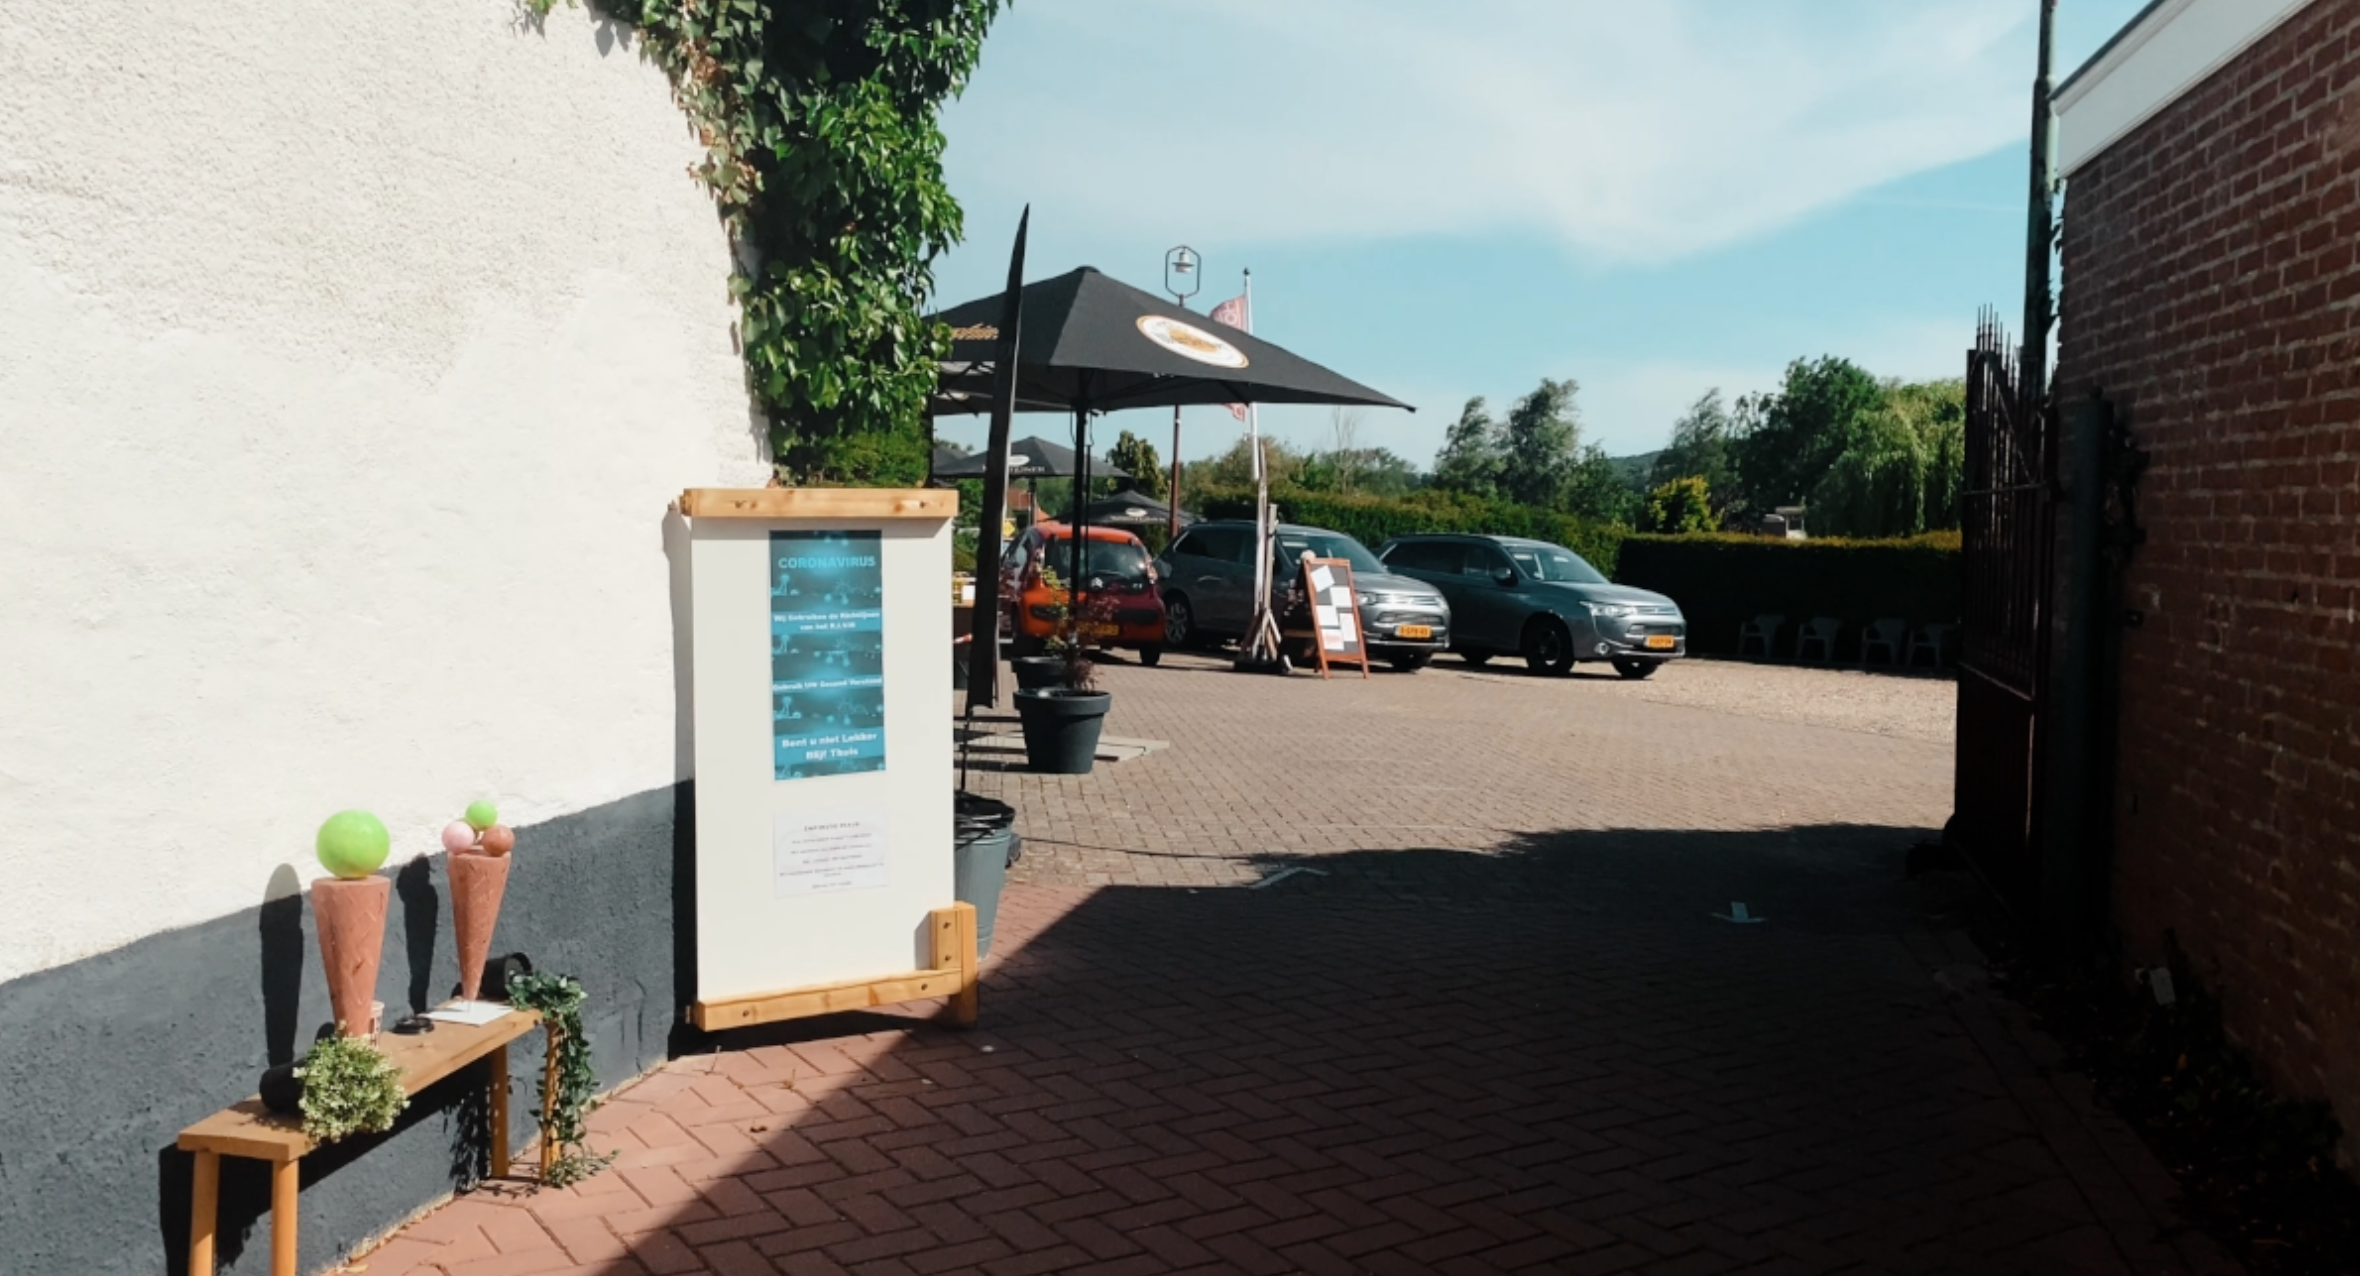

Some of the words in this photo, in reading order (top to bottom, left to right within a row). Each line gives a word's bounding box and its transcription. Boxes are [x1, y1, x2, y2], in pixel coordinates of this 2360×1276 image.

[778, 555, 876, 569] CORONAVIRUS
[774, 614, 787, 623] Wij
[788, 613, 827, 621] Gebruiken
[828, 612, 839, 620] de
[772, 683, 803, 691] Gebruik
[820, 680, 847, 688] Gezond
[849, 677, 882, 686] Verstand
[782, 738, 807, 748] Bent
[810, 737, 818, 746] u
[818, 735, 839, 745] niet
[842, 732, 877, 743] Lekker
[806, 749, 827, 761] Blijf
[831, 747, 859, 757] Thuis
